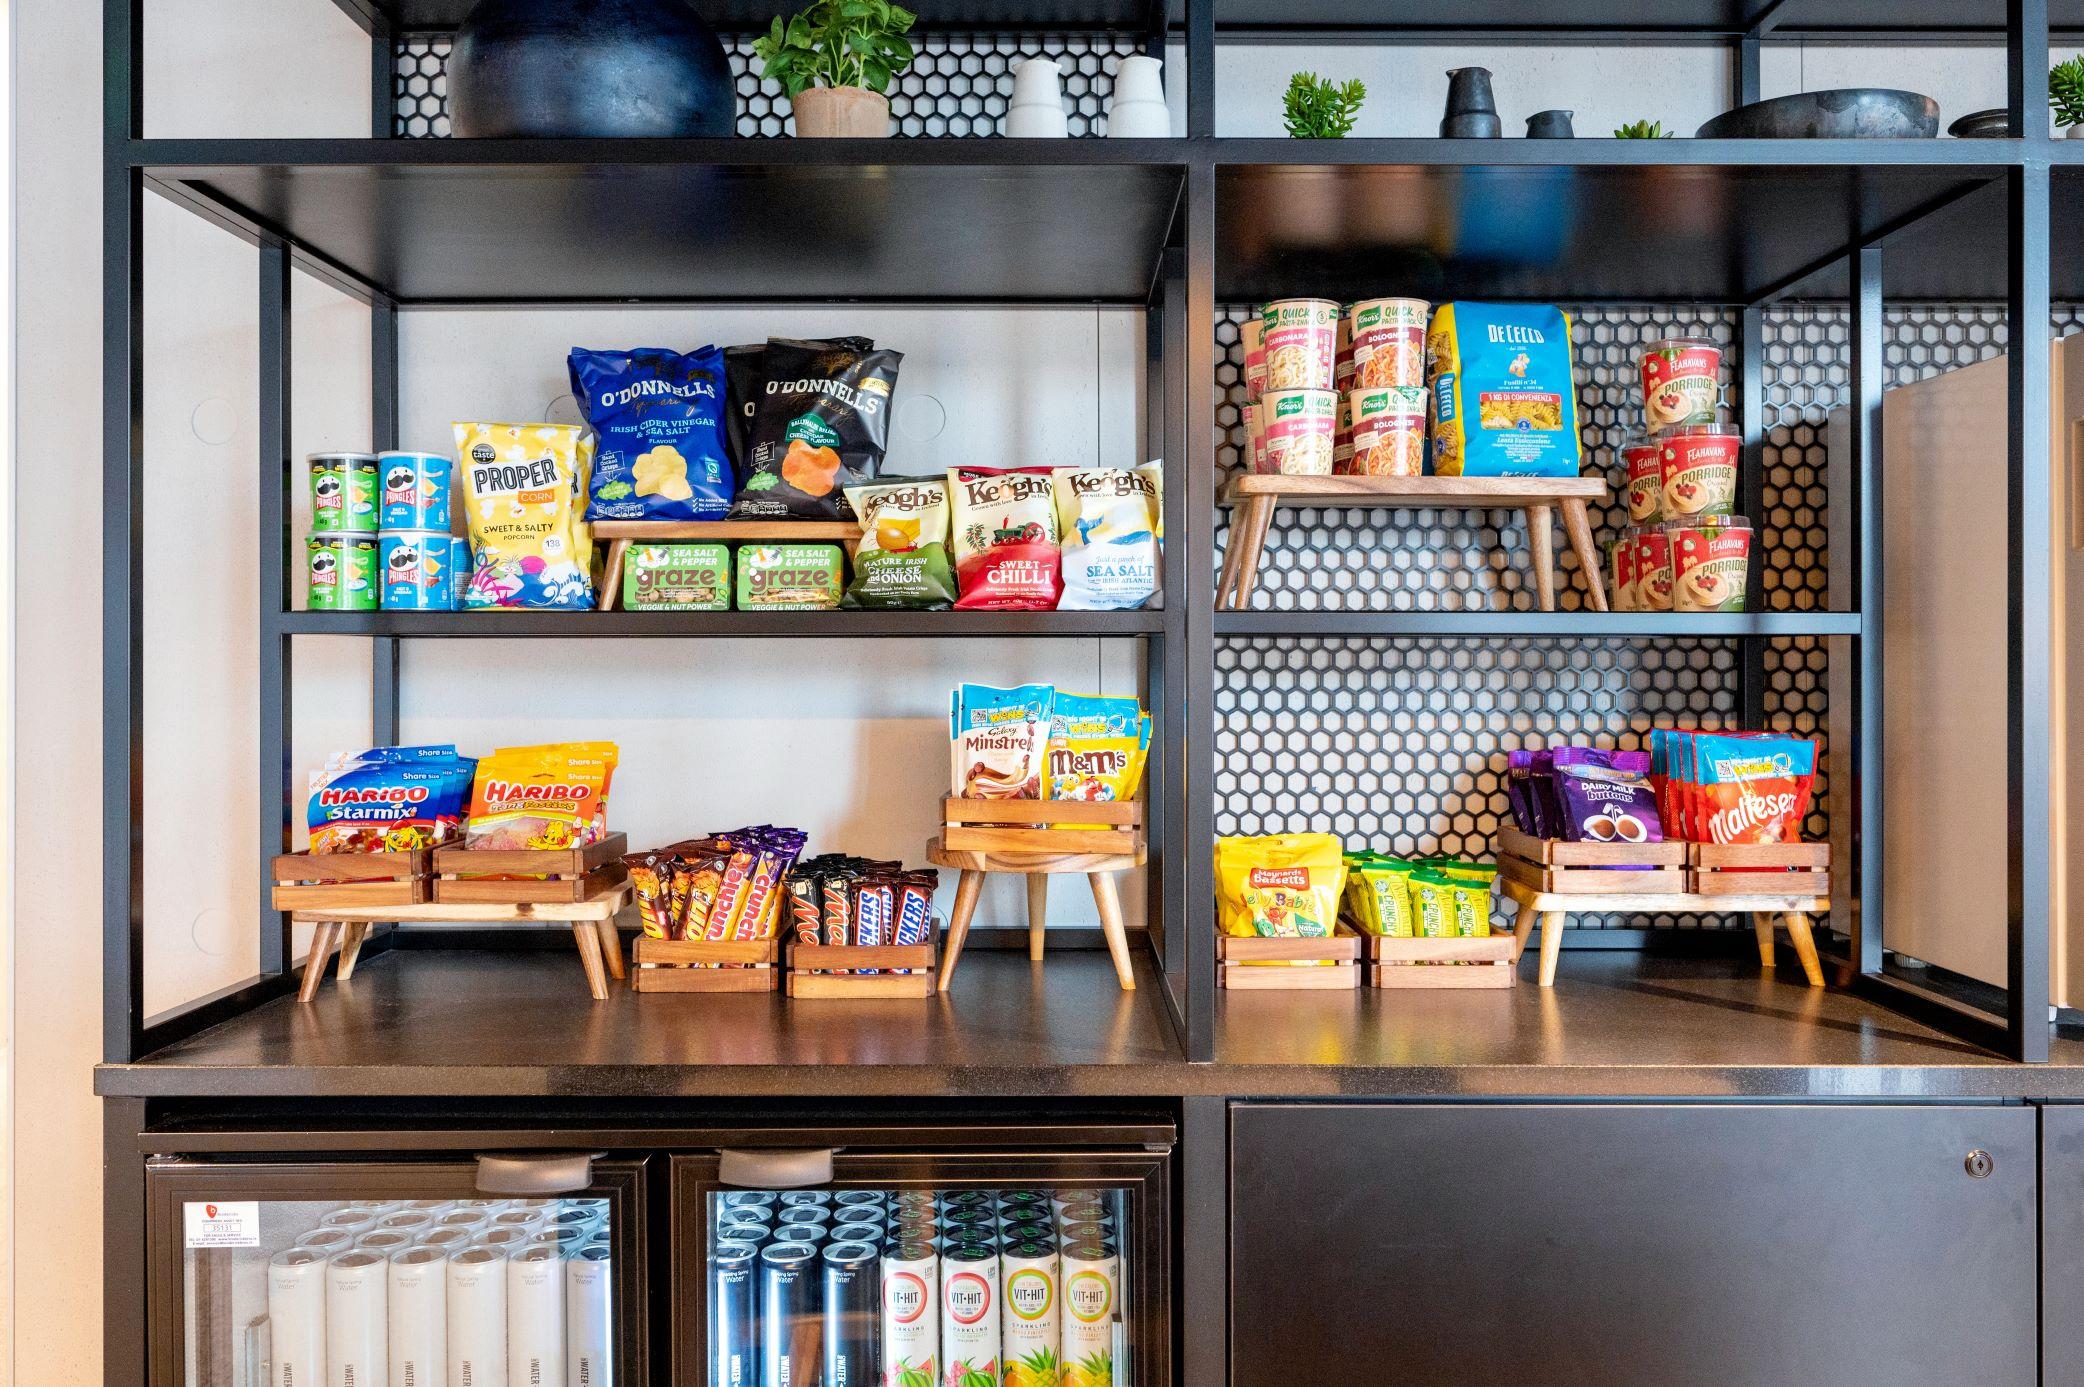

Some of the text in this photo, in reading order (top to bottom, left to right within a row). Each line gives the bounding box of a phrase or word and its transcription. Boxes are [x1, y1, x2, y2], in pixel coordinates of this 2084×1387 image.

[1357, 312, 1379, 324] Knorr
[1507, 325, 1545, 344] CECCO
[1665, 378, 1712, 395] PORRIDGE
[601, 380, 715, 407] O'DONNELLS
[766, 378, 879, 414] O'DONNELLS
[1511, 394, 1552, 402] CONVENIENZA
[640, 419, 668, 430] CIDER
[671, 418, 716, 427] VINEGAR
[645, 428, 664, 436] SEA
[666, 426, 691, 435] SALT
[473, 449, 495, 459] taste
[474, 458, 557, 494] PROPER
[1682, 467, 1732, 484] PORRIDGE
[1067, 469, 1156, 497] Keogh's
[386, 489, 415, 505] PRINGLES
[520, 491, 553, 502] CORN
[965, 476, 1052, 507] Keogh's
[484, 525, 514, 534] SWEET
[525, 523, 554, 532] SALTY
[673, 549, 718, 557] SEA SALT
[786, 550, 831, 558] SEA SALT
[673, 558, 717, 566] & PEPPER
[786, 559, 830, 567] & PEPPER
[999, 561, 1040, 569] SWEET
[389, 568, 420, 585] PRINGLES
[868, 566, 921, 575] CHEESE
[1087, 565, 1154, 577] SEA SALT
[636, 569, 716, 592] graze
[749, 570, 829, 593] graze
[881, 574, 922, 583] ONION
[987, 570, 1051, 584] CHILLI
[487, 781, 590, 801] HARIBO
[1581, 783, 1636, 795] DAIRY MILK
[321, 787, 428, 805] HARIBO
[1588, 791, 1633, 803] buttons
[331, 802, 413, 820] Starmix
[1254, 873, 1305, 885] Bassetts
[1259, 869, 1301, 877] Maynards
[705, 869, 743, 940] unchie
[1384, 895, 1398, 933] CRUNCHY
